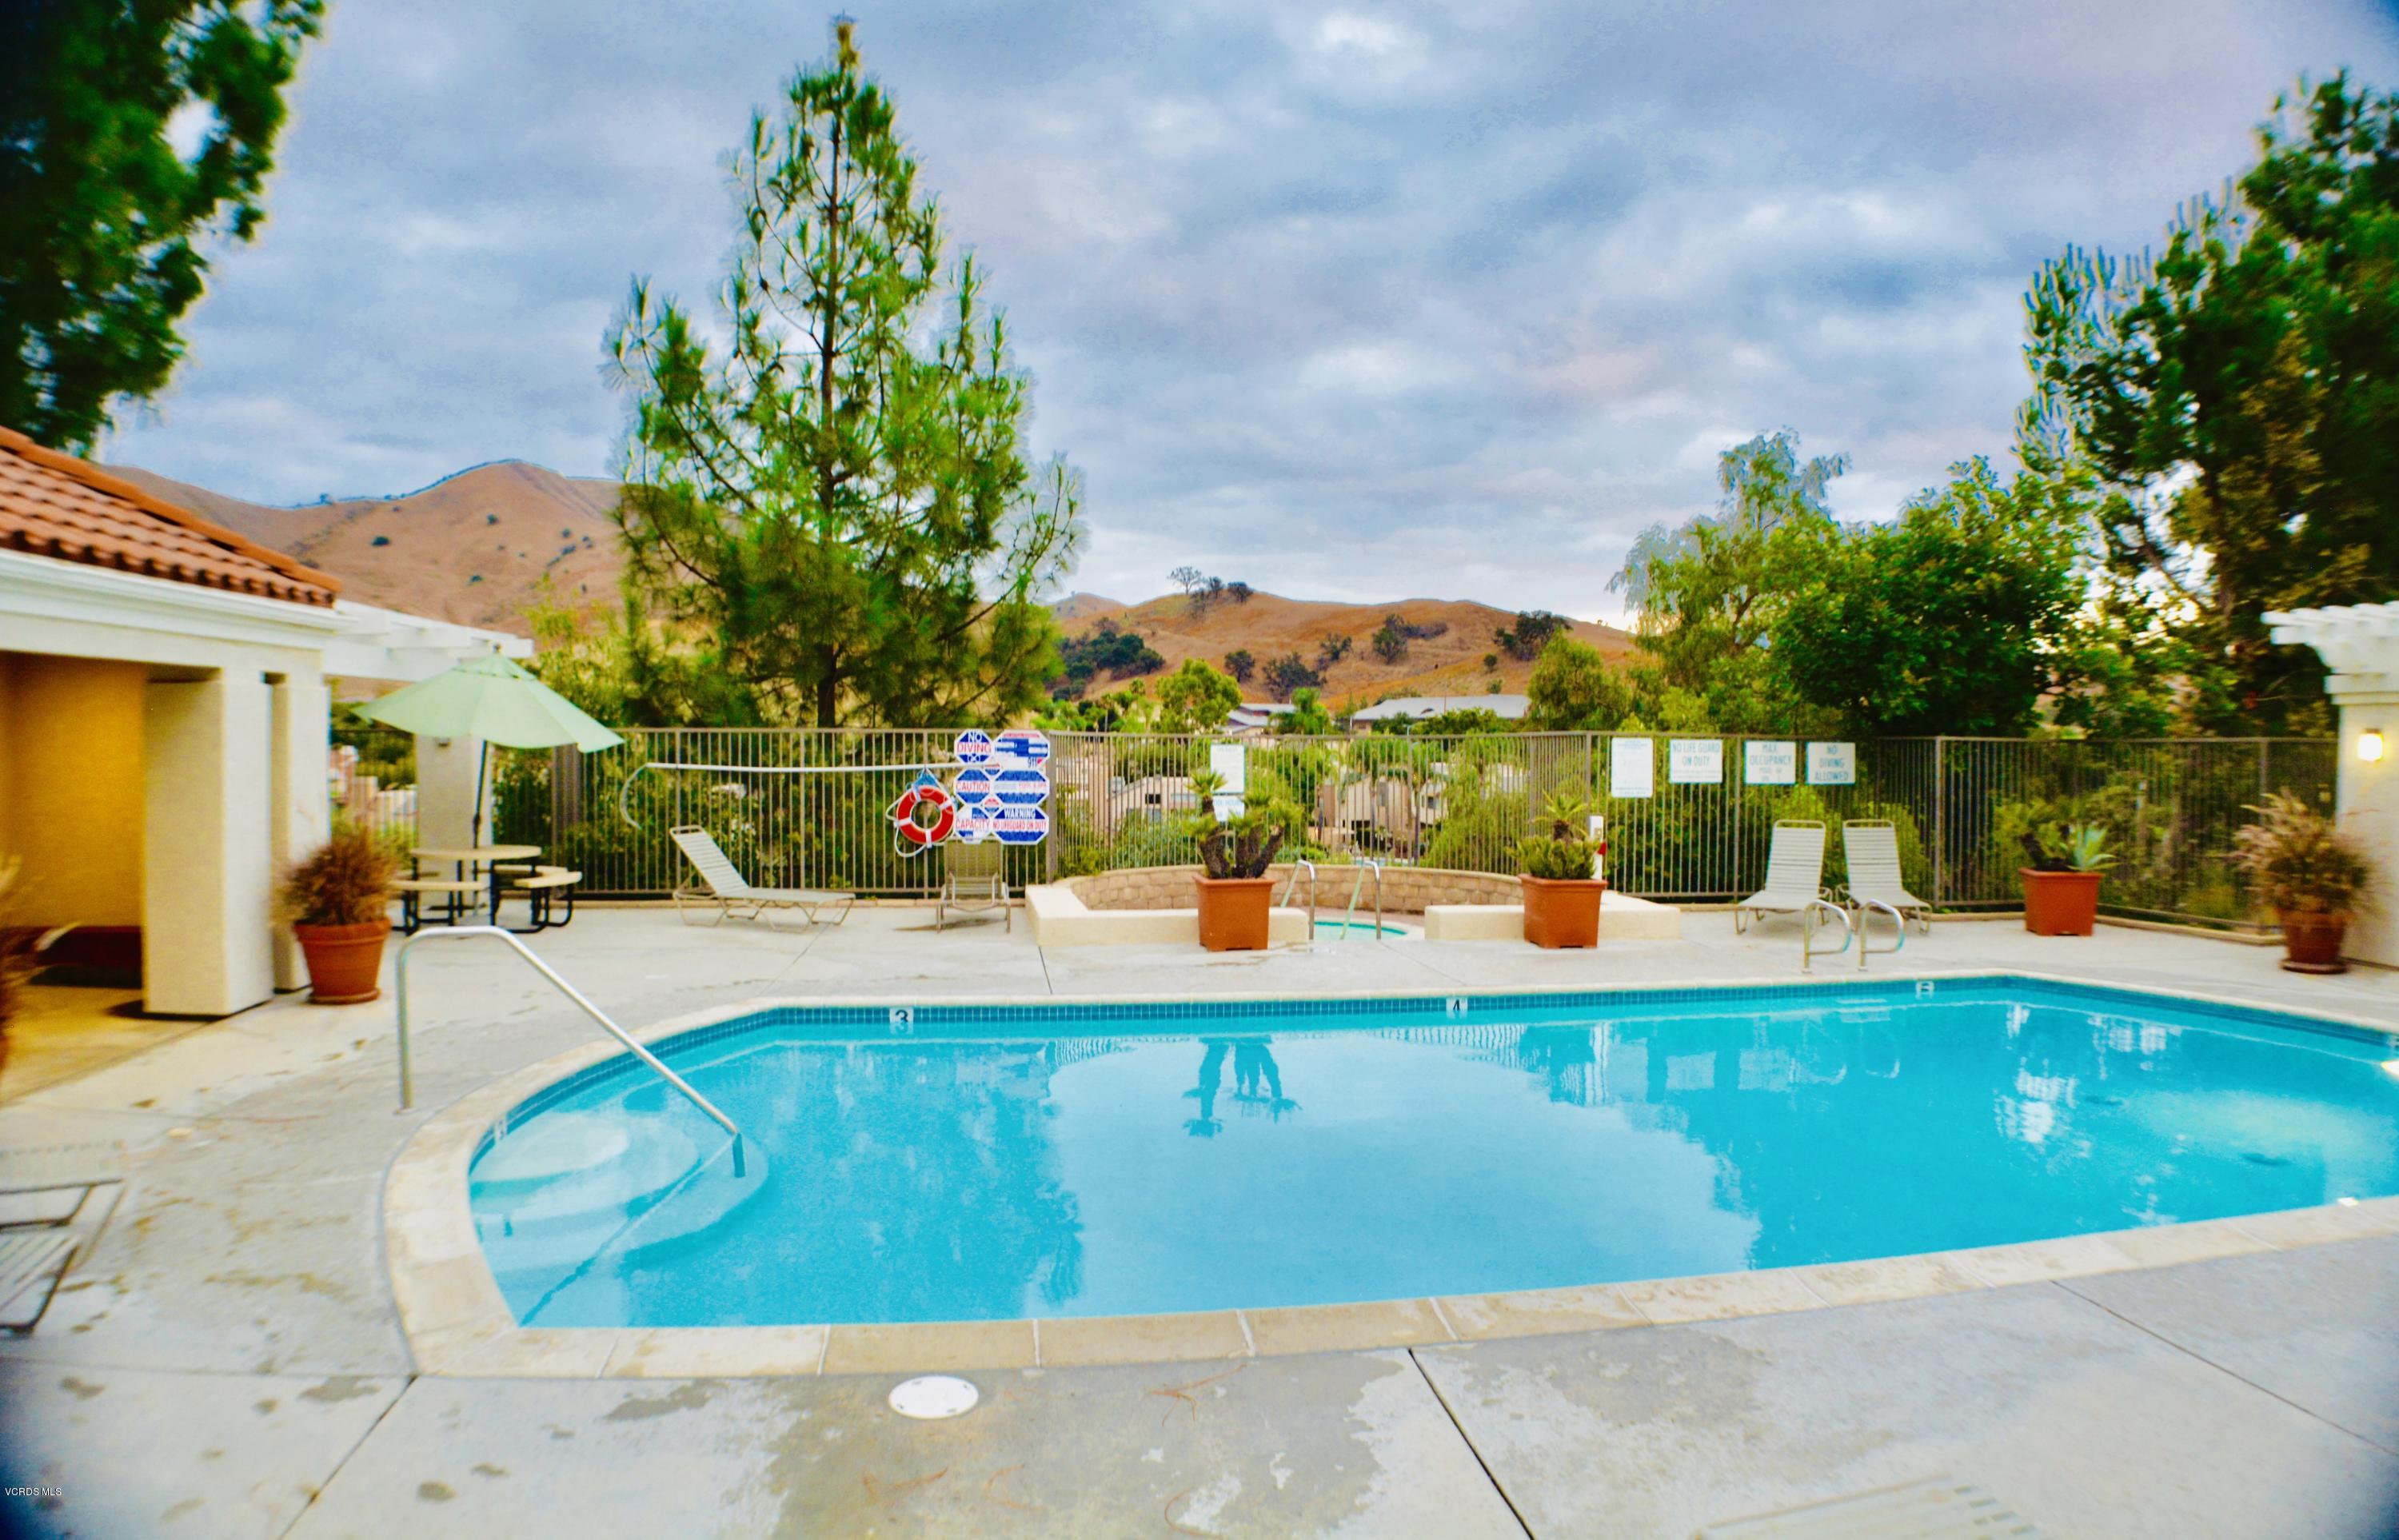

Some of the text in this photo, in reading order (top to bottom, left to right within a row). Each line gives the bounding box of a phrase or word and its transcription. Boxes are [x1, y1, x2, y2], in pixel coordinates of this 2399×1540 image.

[968, 732, 982, 742] NO
[957, 742, 992, 753] DIVING
[1694, 755, 1710, 766] DUTY
[1814, 770, 1849, 781] ALLOWED
[956, 781, 990, 792] CAUTION
[1004, 808, 1036, 819] WARNING
[956, 820, 990, 829] CAPACITY
